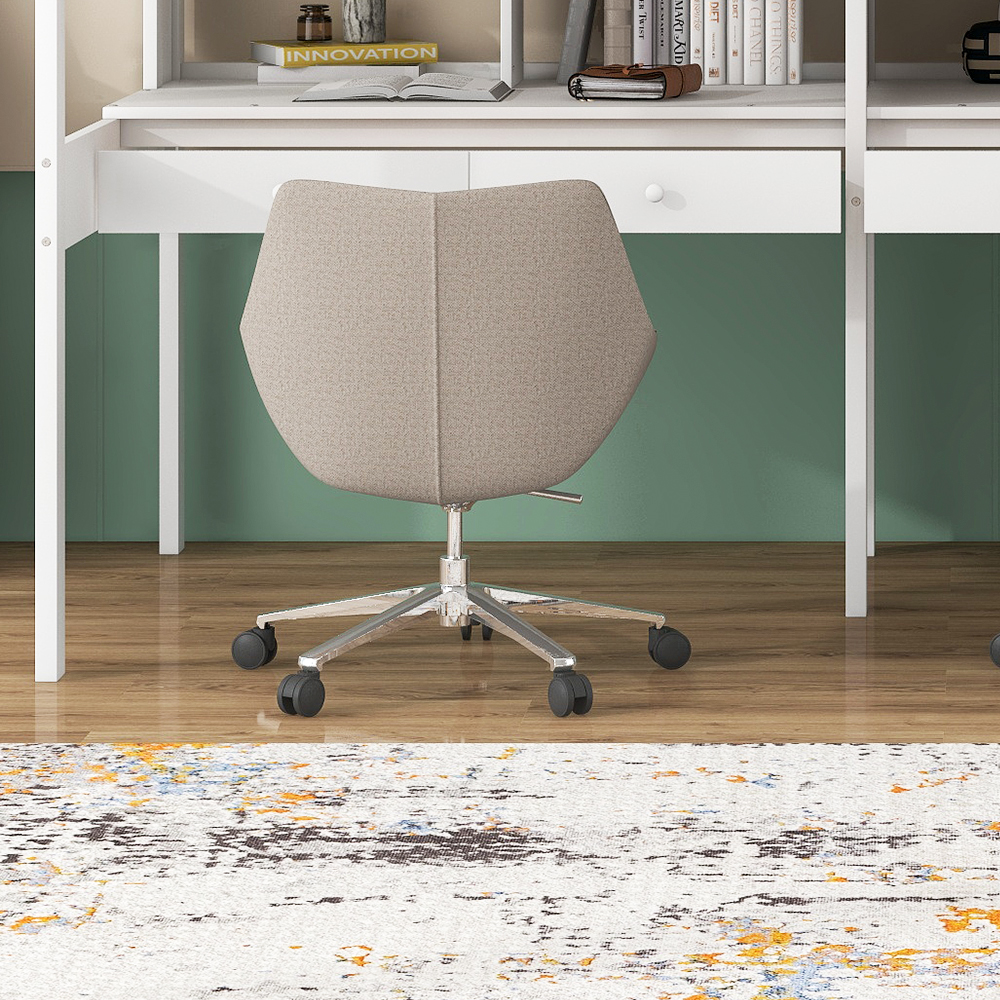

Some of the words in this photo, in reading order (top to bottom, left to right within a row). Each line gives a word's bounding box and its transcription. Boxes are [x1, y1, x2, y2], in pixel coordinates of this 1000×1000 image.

[708, 2, 719, 23] DIET
[638, 12, 647, 40] TWIST
[749, 7, 763, 67] CHANEL
[286, 47, 437, 62] INNOVATION
